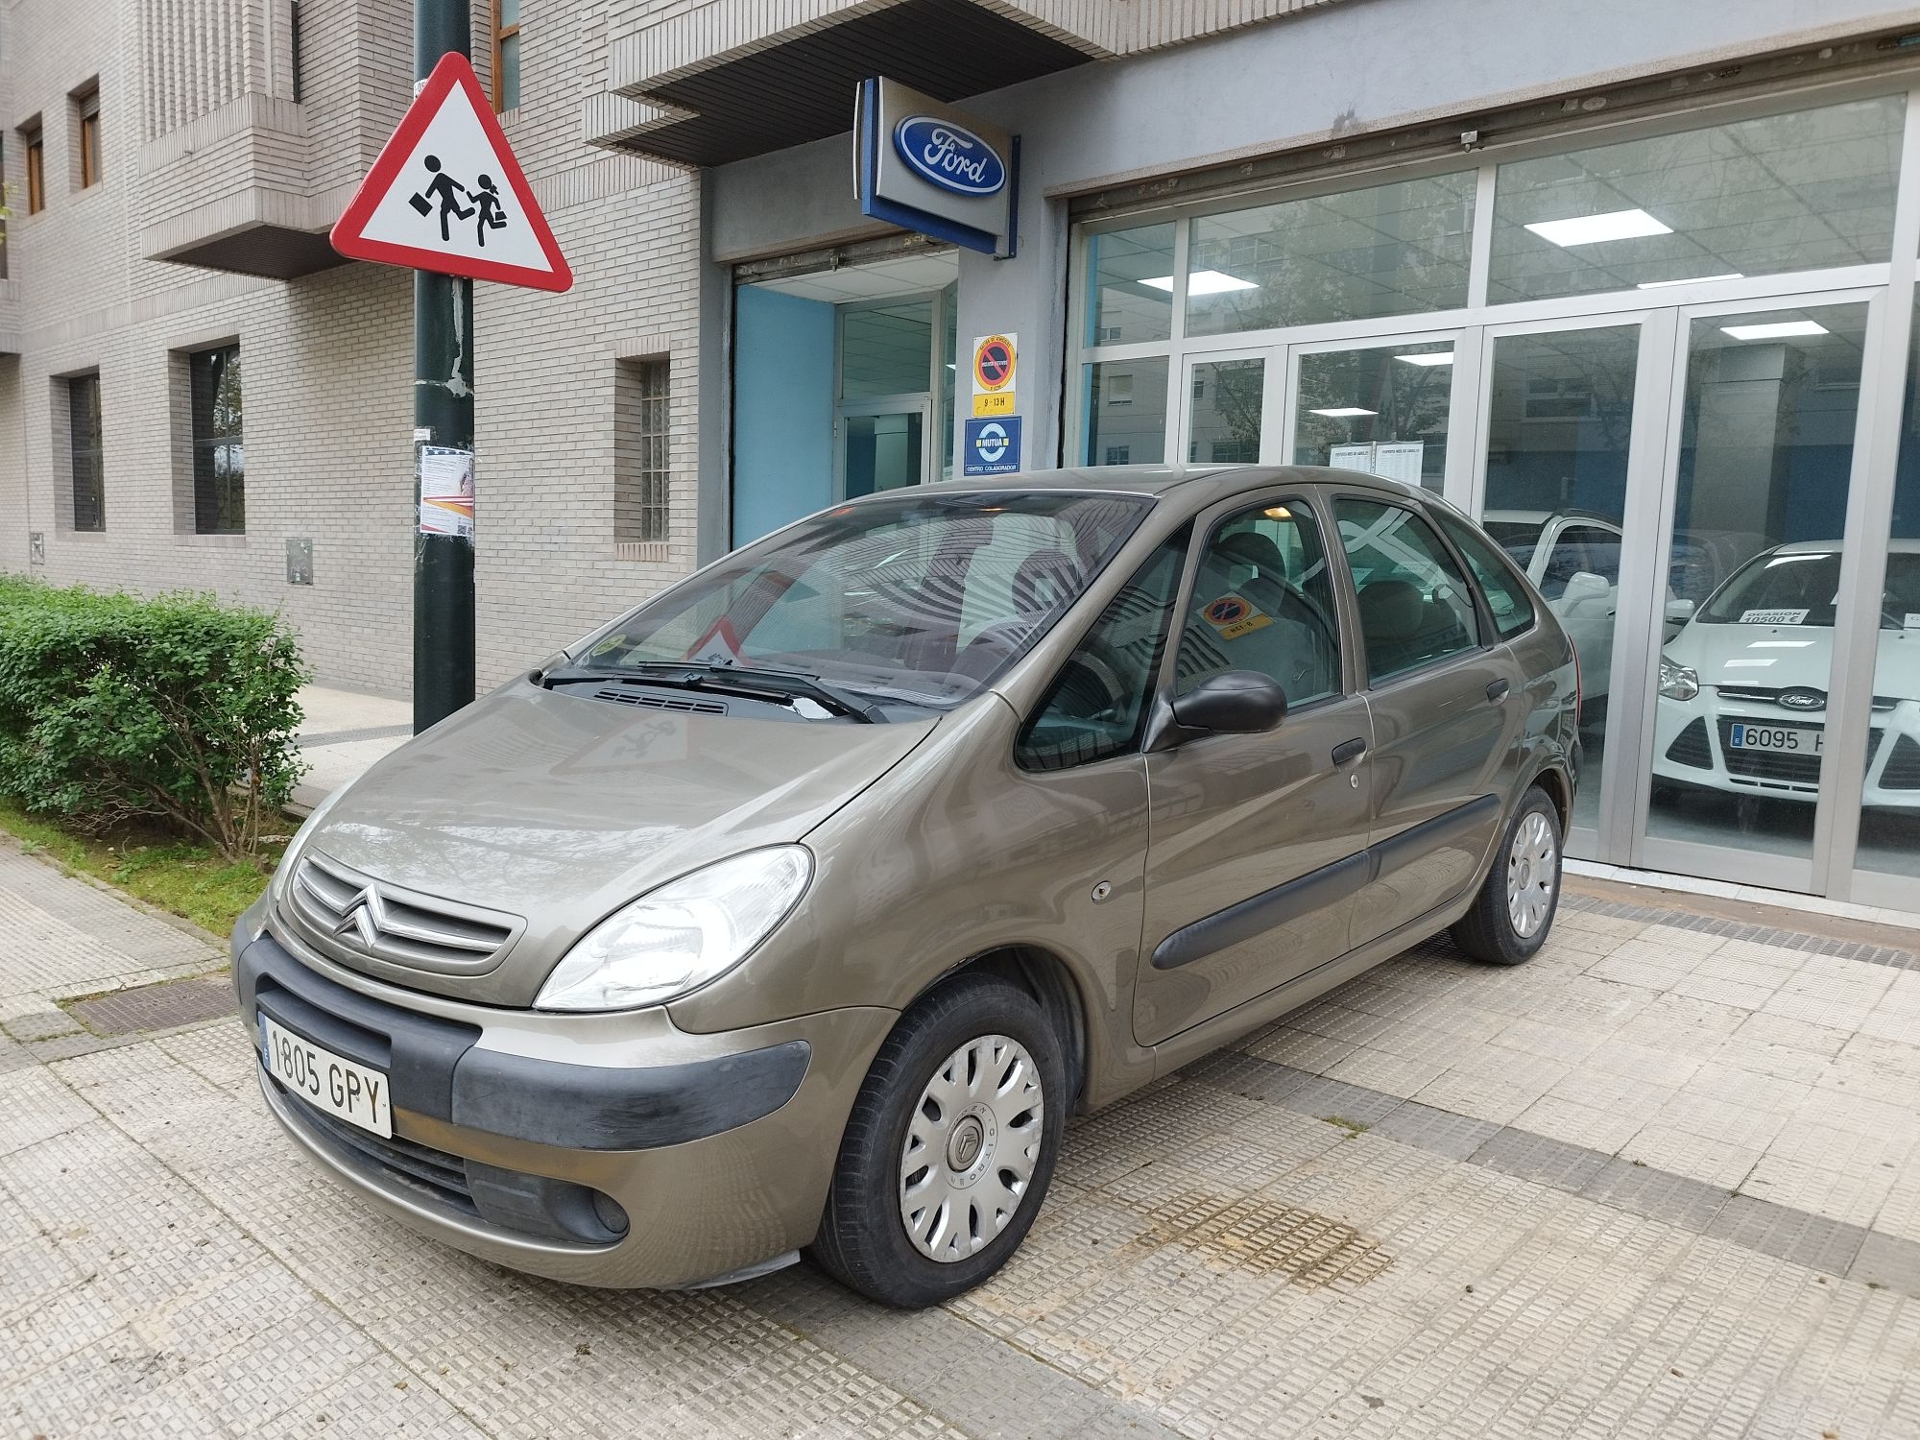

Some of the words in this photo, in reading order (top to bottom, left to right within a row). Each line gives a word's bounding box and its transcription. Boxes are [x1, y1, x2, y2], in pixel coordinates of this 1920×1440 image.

[924, 128, 987, 183] Ford
[981, 438, 1003, 448] MUTUA
[1788, 695, 1814, 705] Ford
[1745, 728, 1799, 750] 6095
[272, 1030, 320, 1096] 1805
[329, 1063, 379, 1124] GPY
